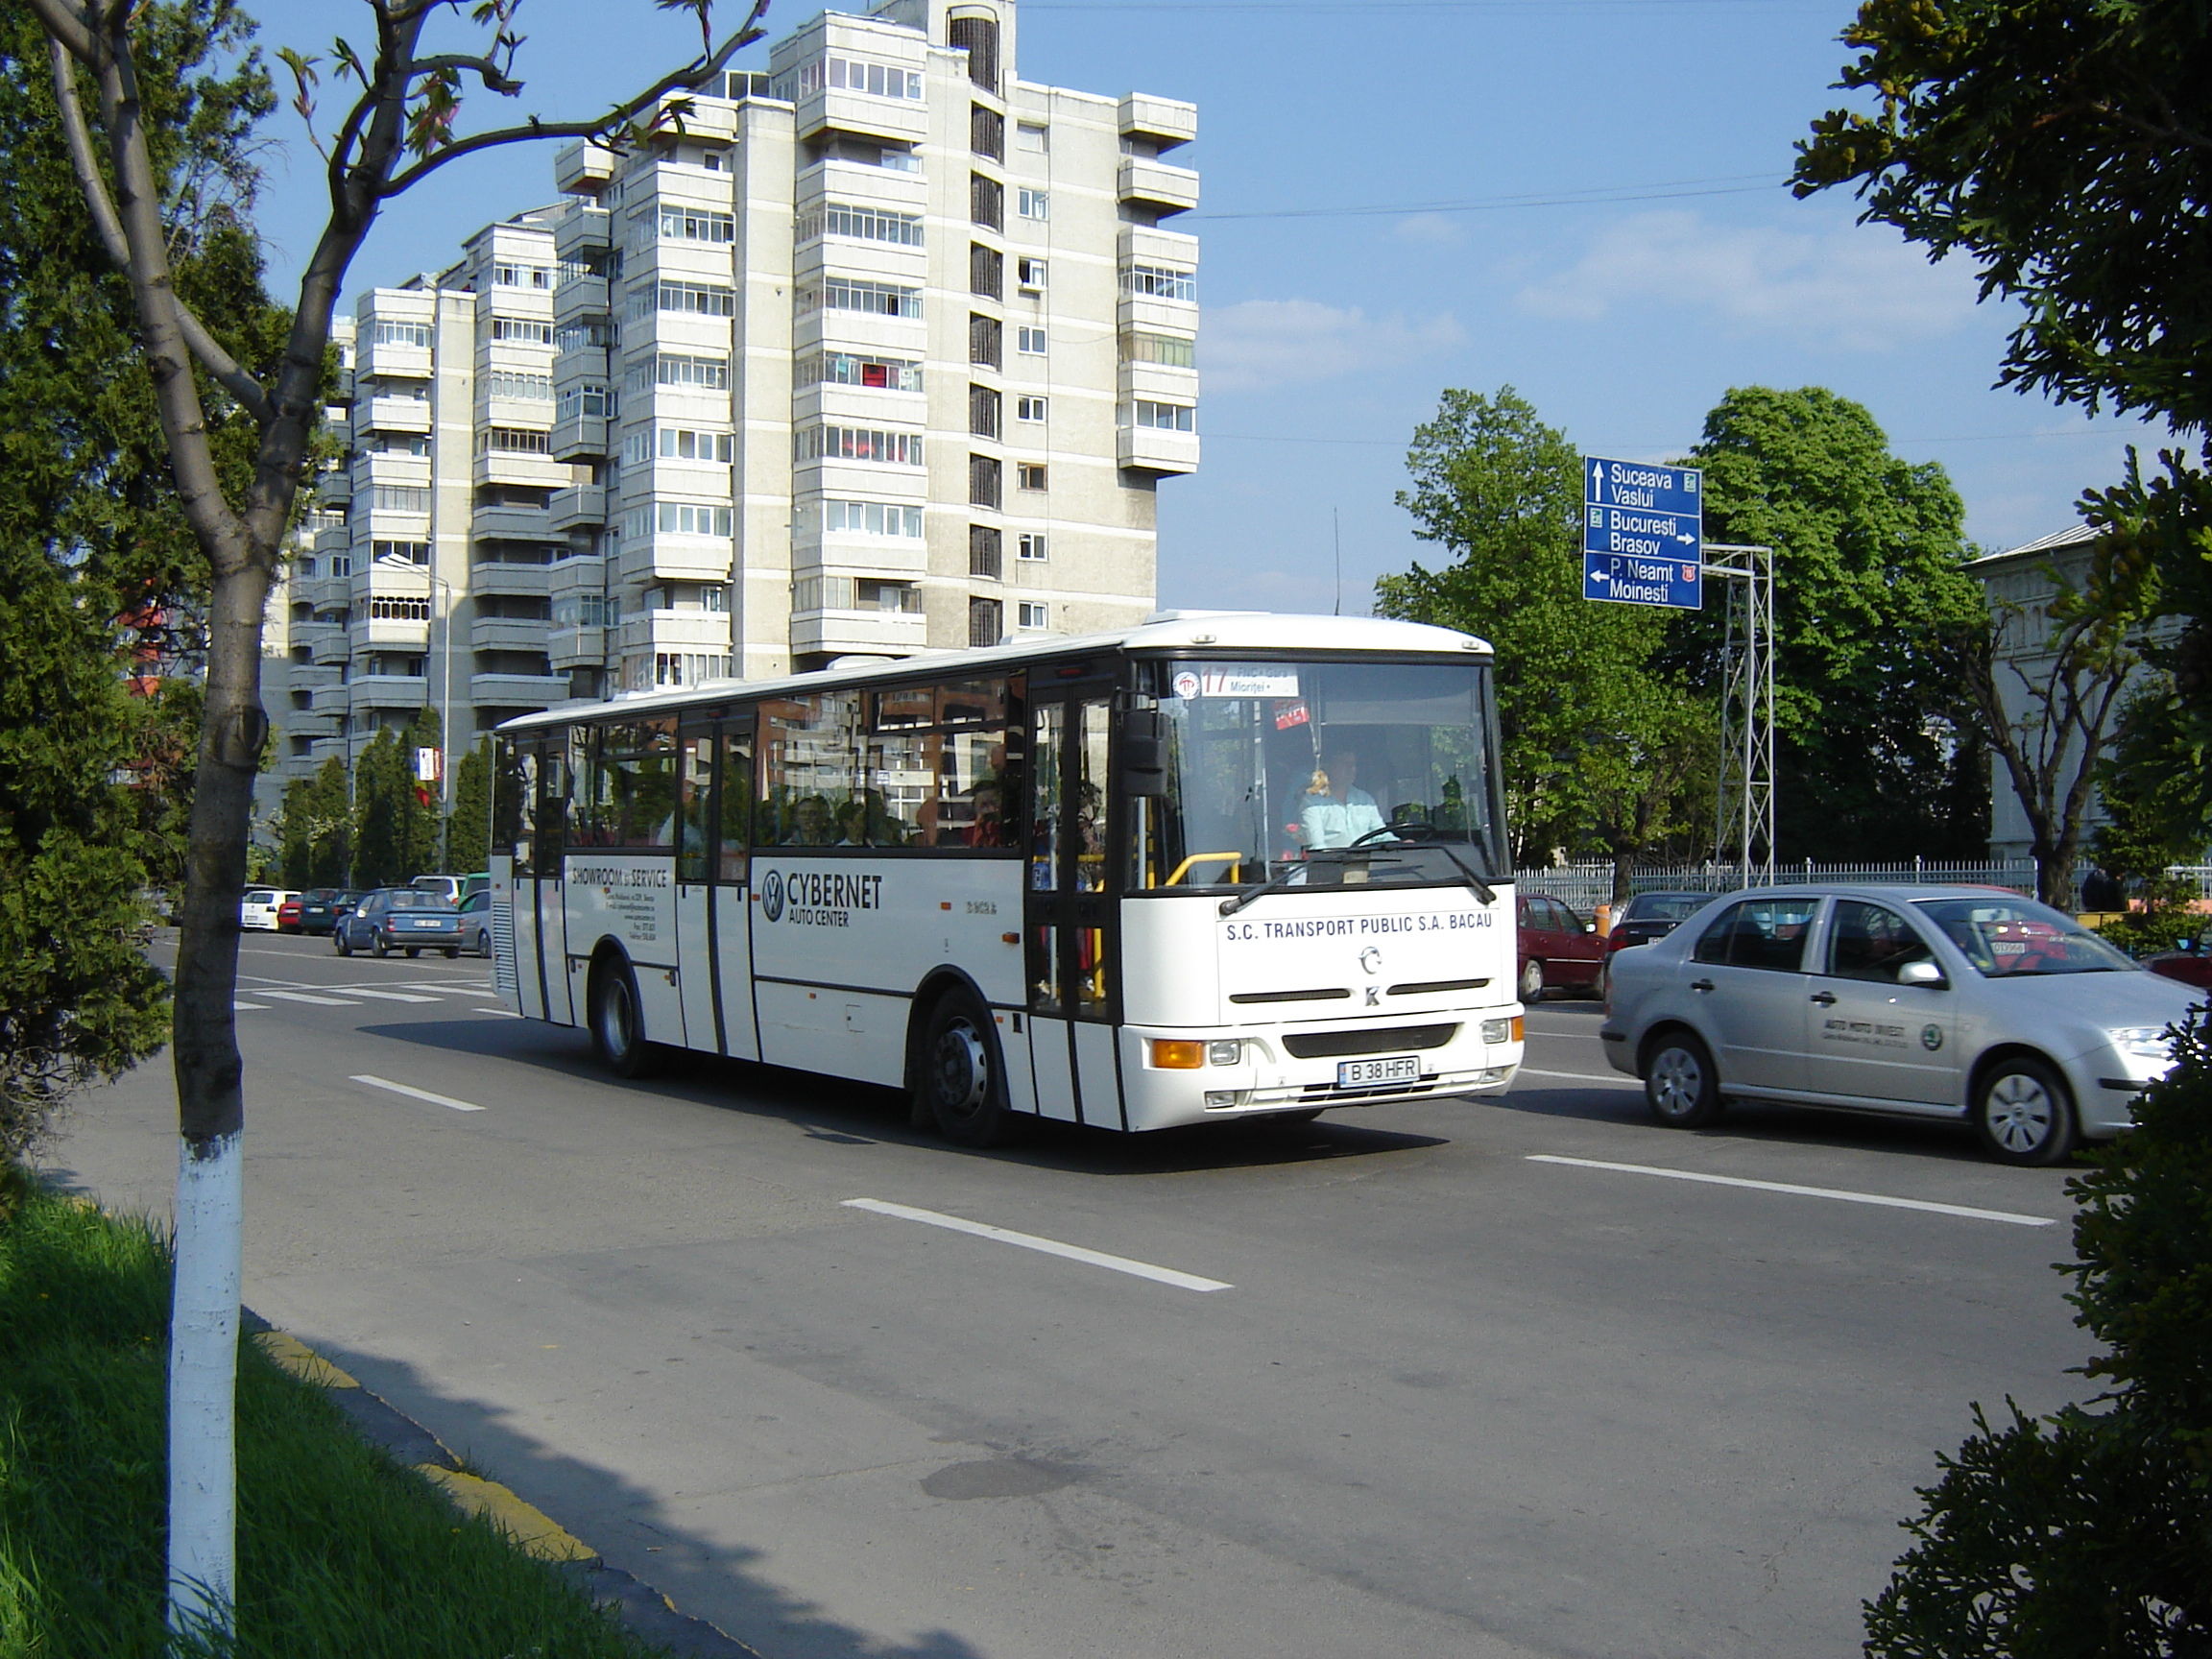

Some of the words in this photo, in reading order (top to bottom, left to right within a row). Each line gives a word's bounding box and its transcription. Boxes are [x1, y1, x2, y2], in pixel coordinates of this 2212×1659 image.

[1610, 464, 1672, 490] Suceava
[1610, 484, 1654, 508] Vaslui
[1610, 557, 1623, 576] P.
[1202, 666, 1229, 693] 17
[572, 867, 623, 886] SHOWROOM
[632, 869, 667, 888] SERVICE
[787, 873, 882, 910] CYBERNET
[788, 908, 813, 926] AUTO
[814, 909, 850, 927] CENTER
[1226, 925, 1259, 941] S.C.
[1263, 919, 1356, 939] TRANSPORT
[1360, 916, 1413, 934] PUBLIC
[1418, 915, 1445, 931] S.A.
[1449, 913, 1493, 929] BACAU
[1351, 1065, 1361, 1081] B
[1366, 1063, 1382, 1079] 38
[1385, 1060, 1415, 1077] HFR
